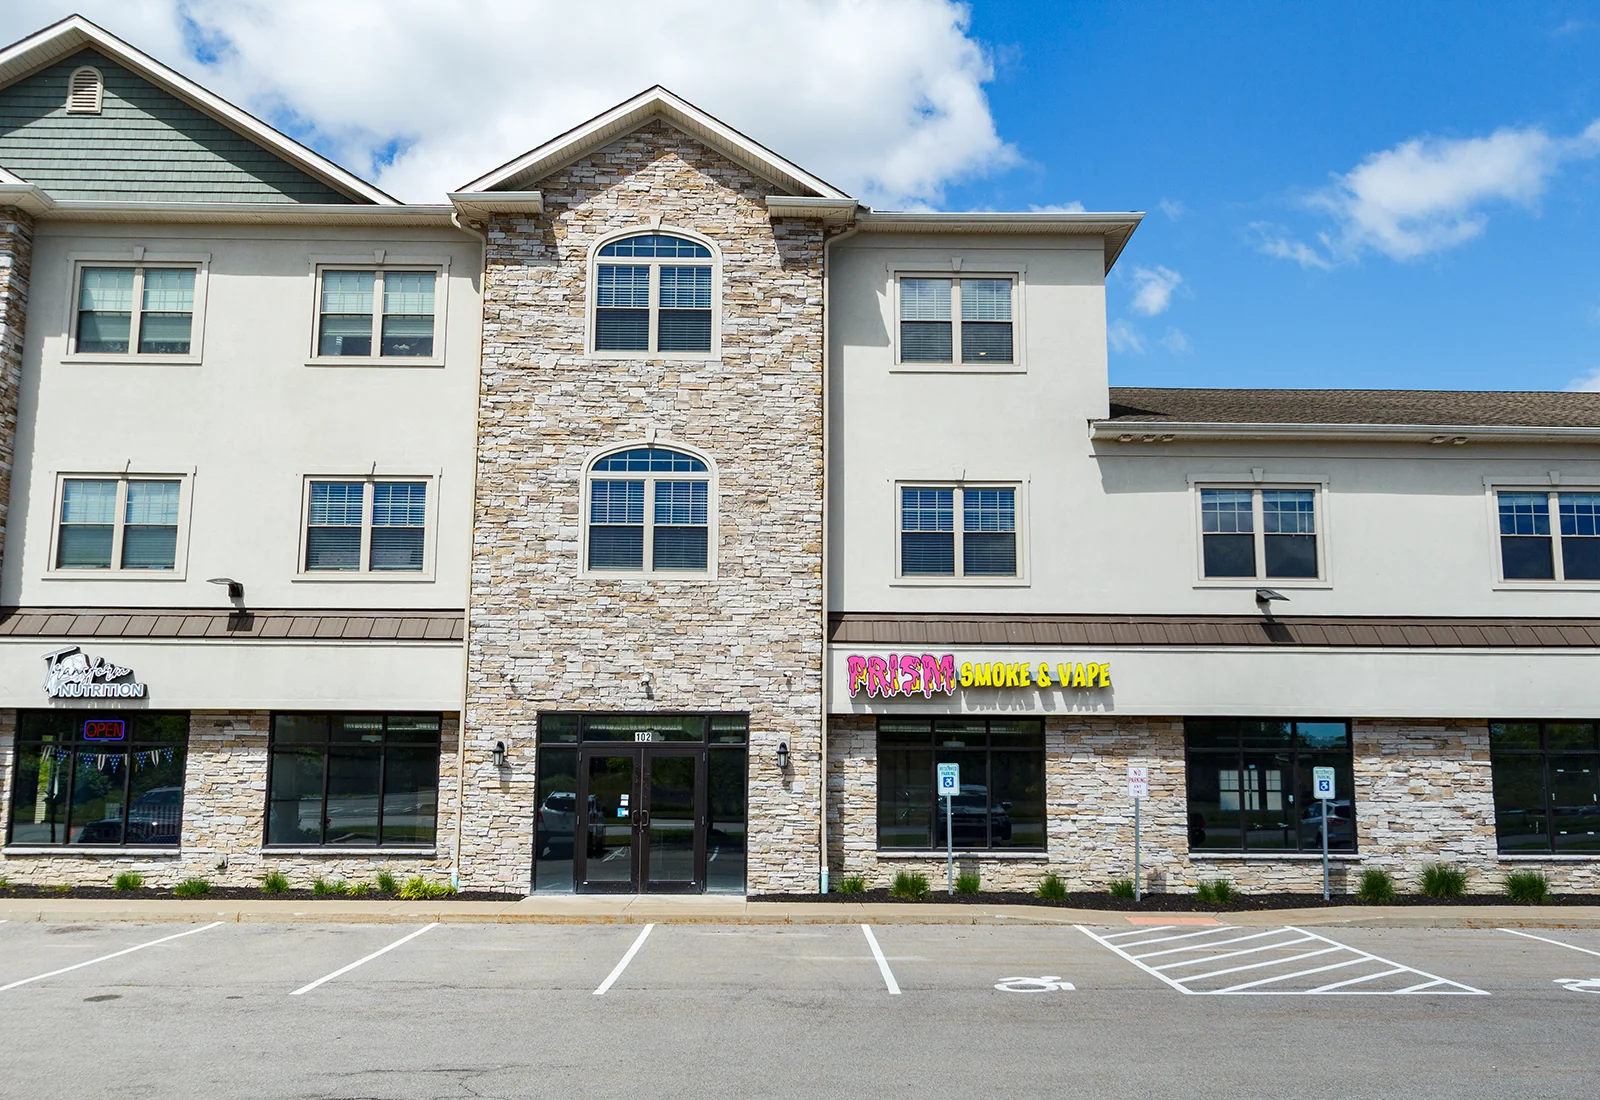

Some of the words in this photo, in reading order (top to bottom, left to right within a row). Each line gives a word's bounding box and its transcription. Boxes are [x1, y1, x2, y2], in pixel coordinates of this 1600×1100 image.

[41, 645, 131, 691] Transform
[846, 653, 956, 699] PRISM
[961, 661, 1032, 688] SMOKE
[1037, 661, 1052, 688] &
[1057, 661, 1111, 688] VAPE
[58, 683, 144, 697] NUTRITION
[85, 722, 123, 738] OPEN
[636, 732, 651, 742] 102
